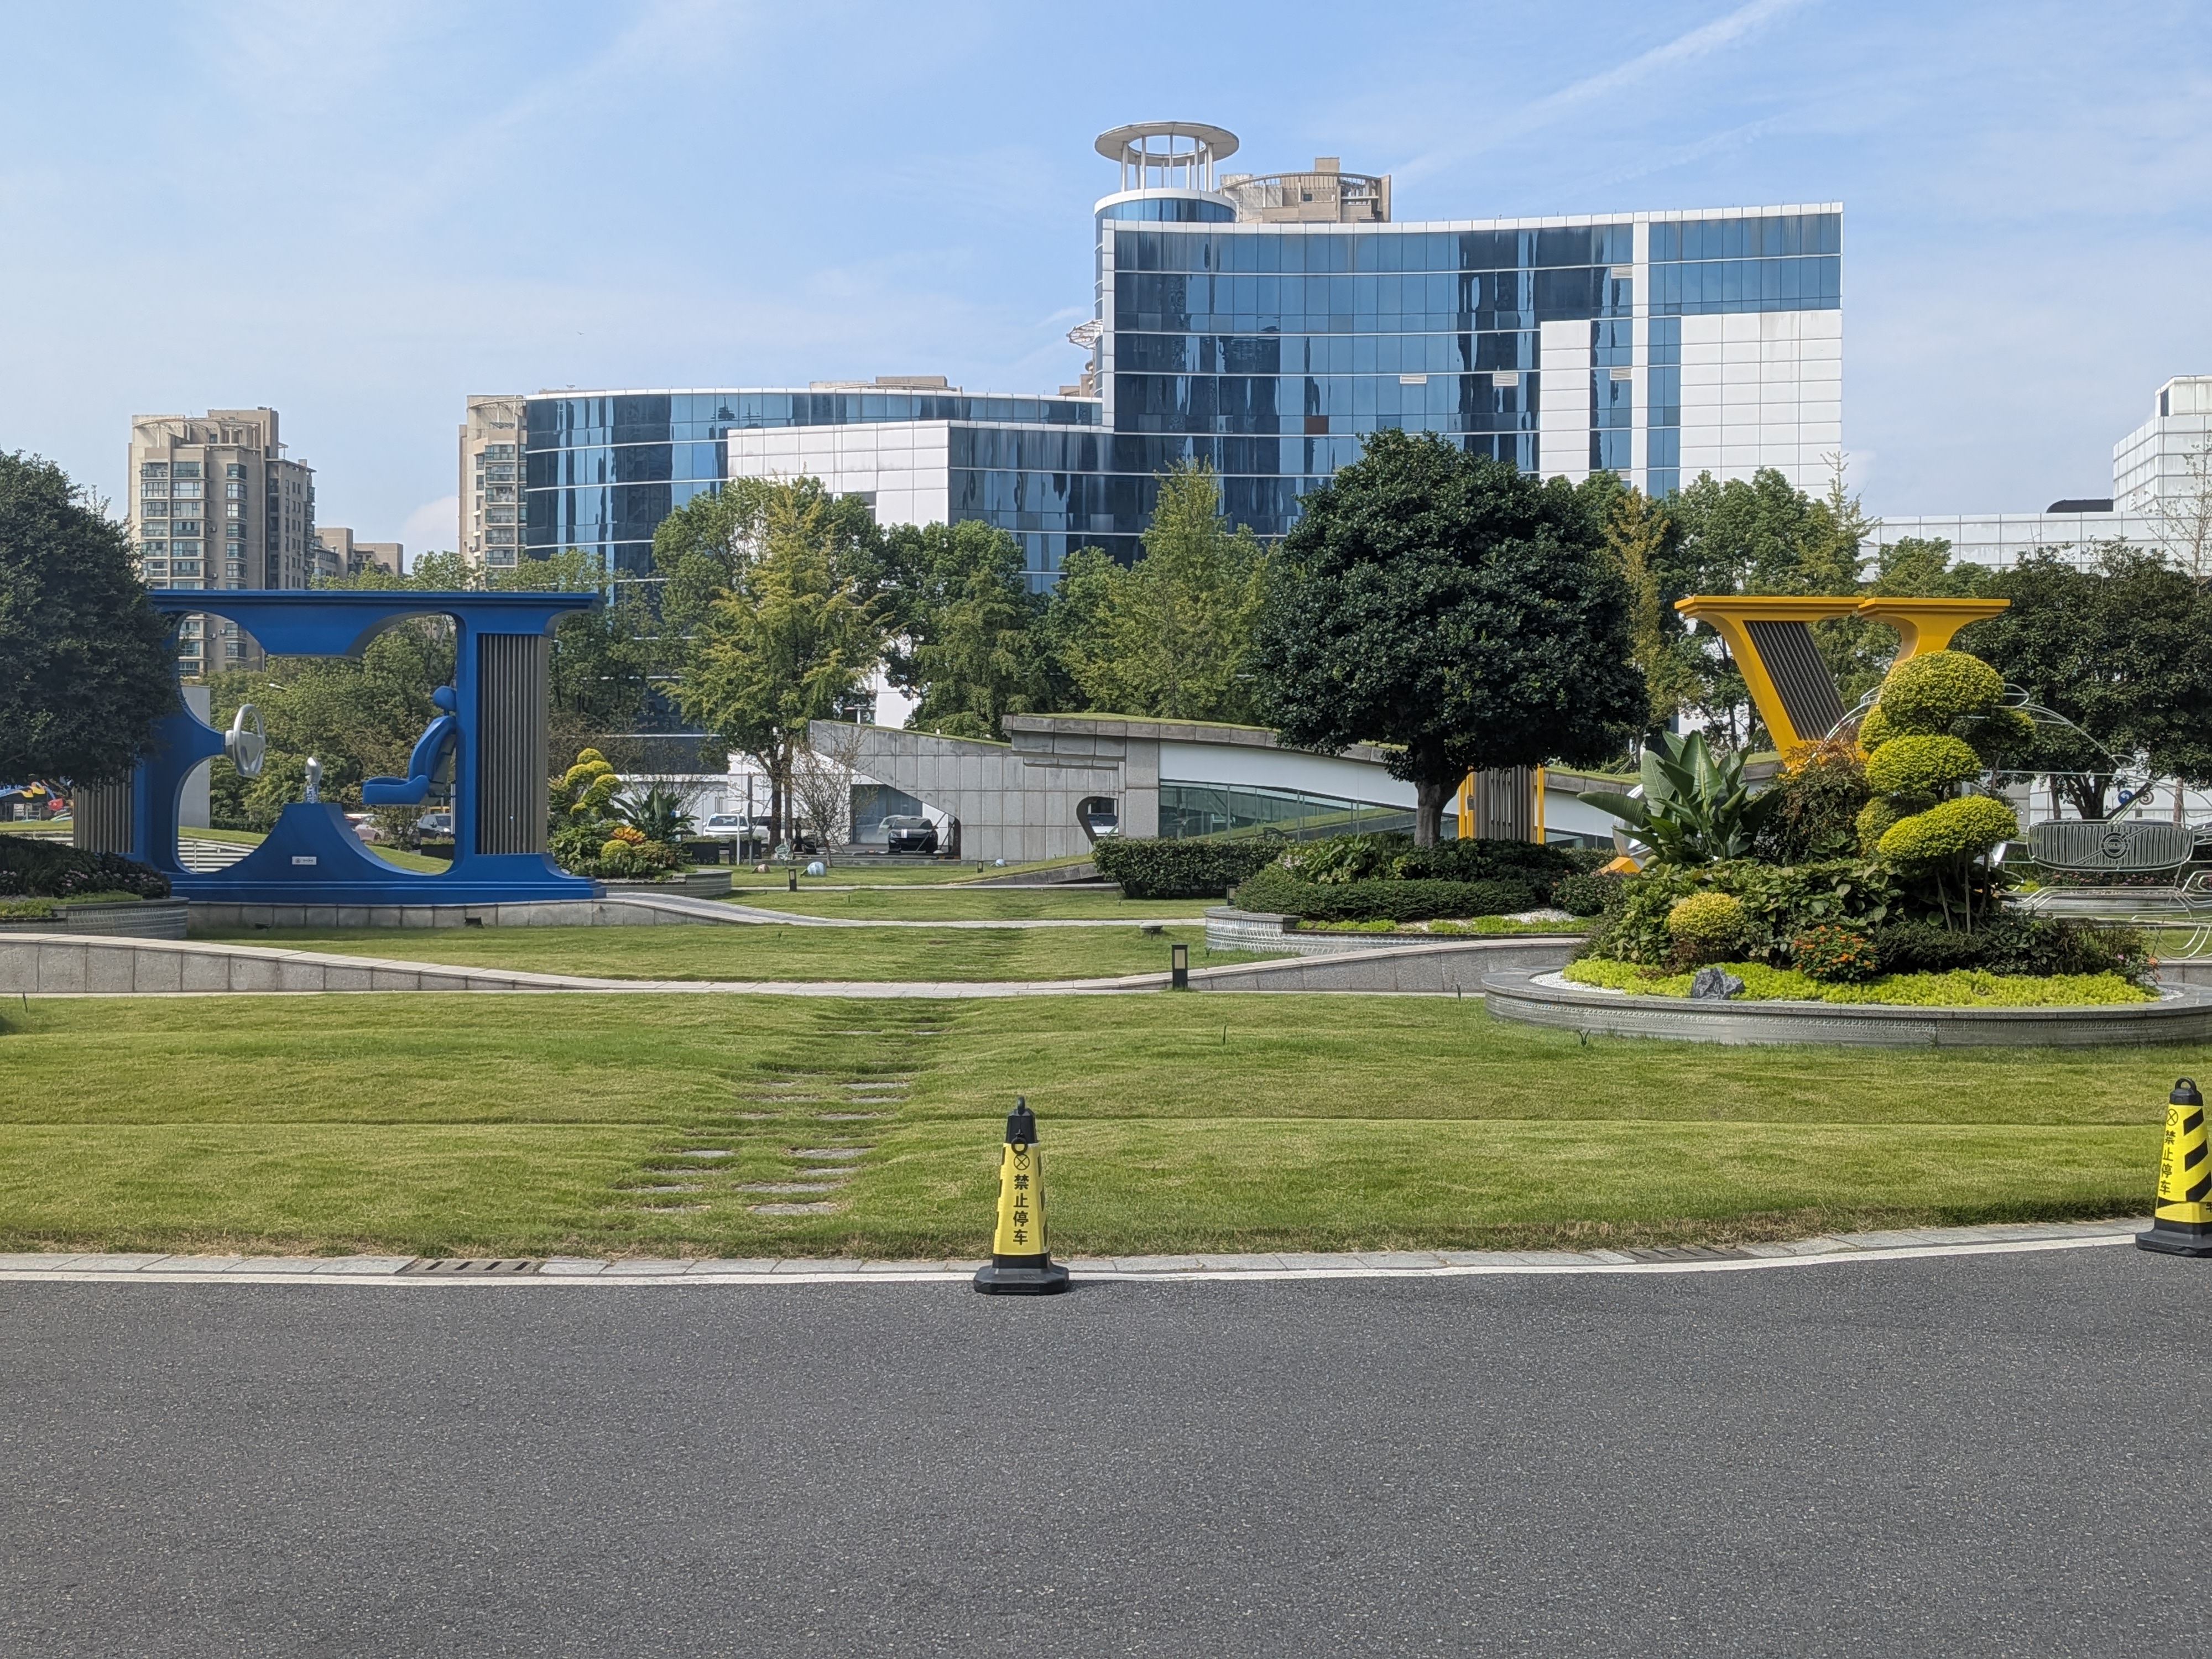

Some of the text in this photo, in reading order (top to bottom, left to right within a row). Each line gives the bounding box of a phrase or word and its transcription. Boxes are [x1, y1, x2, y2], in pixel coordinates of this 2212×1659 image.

[2159, 1130, 2176, 1195] 禁止停车
[1013, 1173, 1029, 1245] 禁止停车
